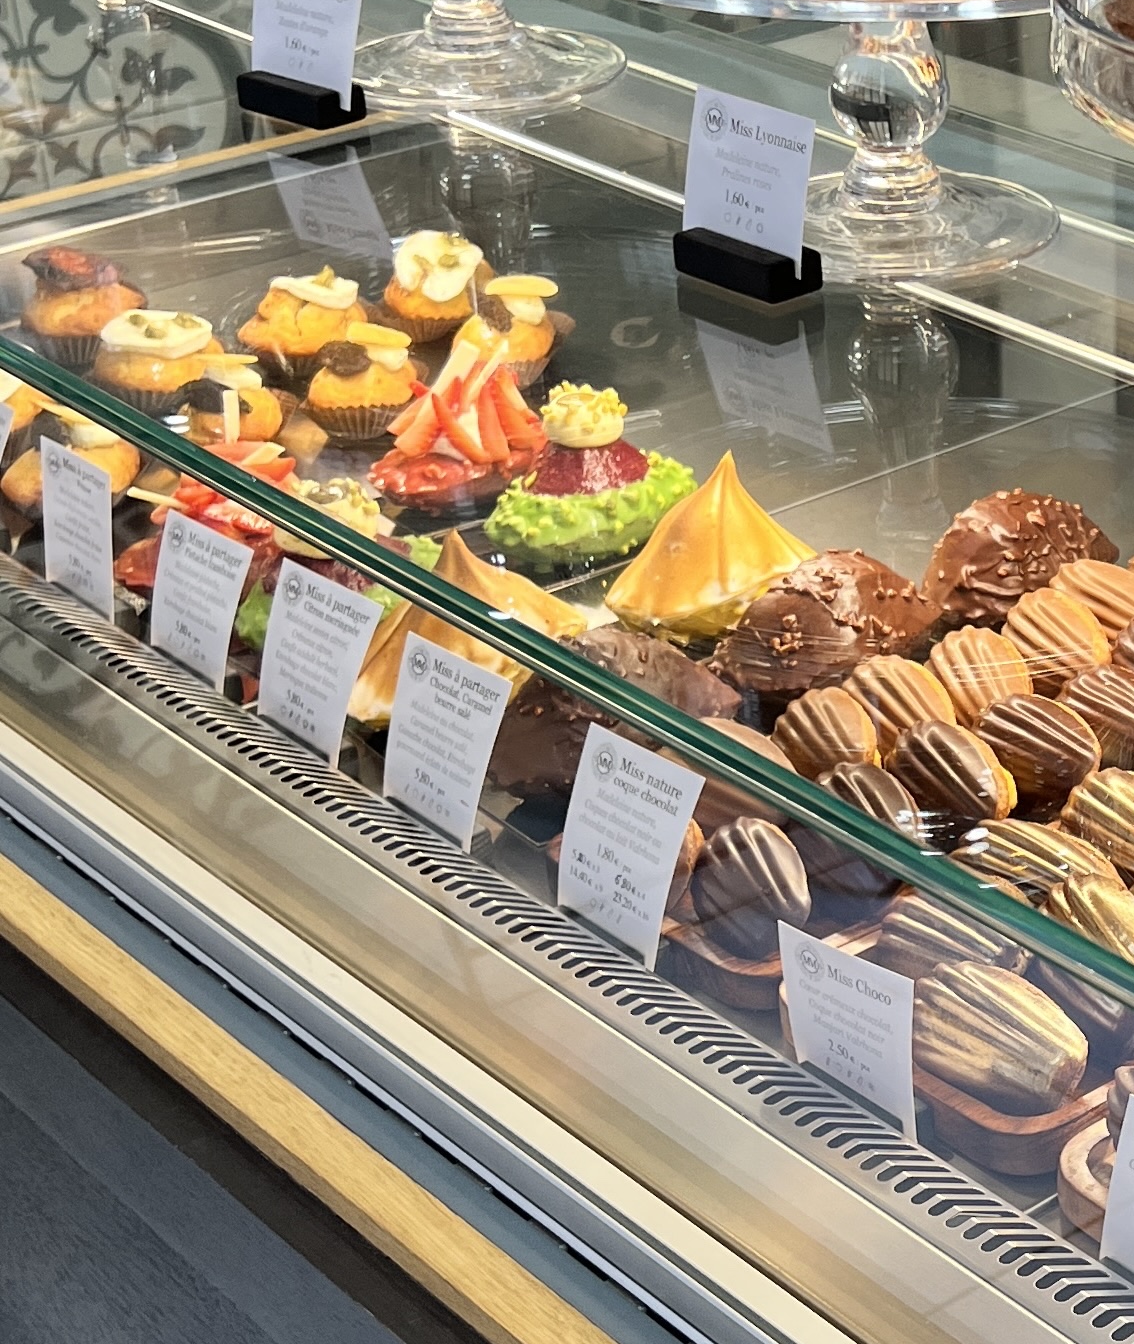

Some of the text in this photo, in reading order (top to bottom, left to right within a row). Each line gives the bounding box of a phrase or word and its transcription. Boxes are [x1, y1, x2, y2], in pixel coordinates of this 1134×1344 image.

[729, 117, 806, 154] Miss Lyonnaise
[305, 583, 370, 624] Miss à partager
[432, 658, 500, 702] Miss à partager
[613, 776, 639, 796] coque
[640, 789, 678, 816] chocolat
[619, 757, 644, 780] Miss
[645, 774, 682, 800] nature
[827, 964, 891, 1005] Miss Choco
